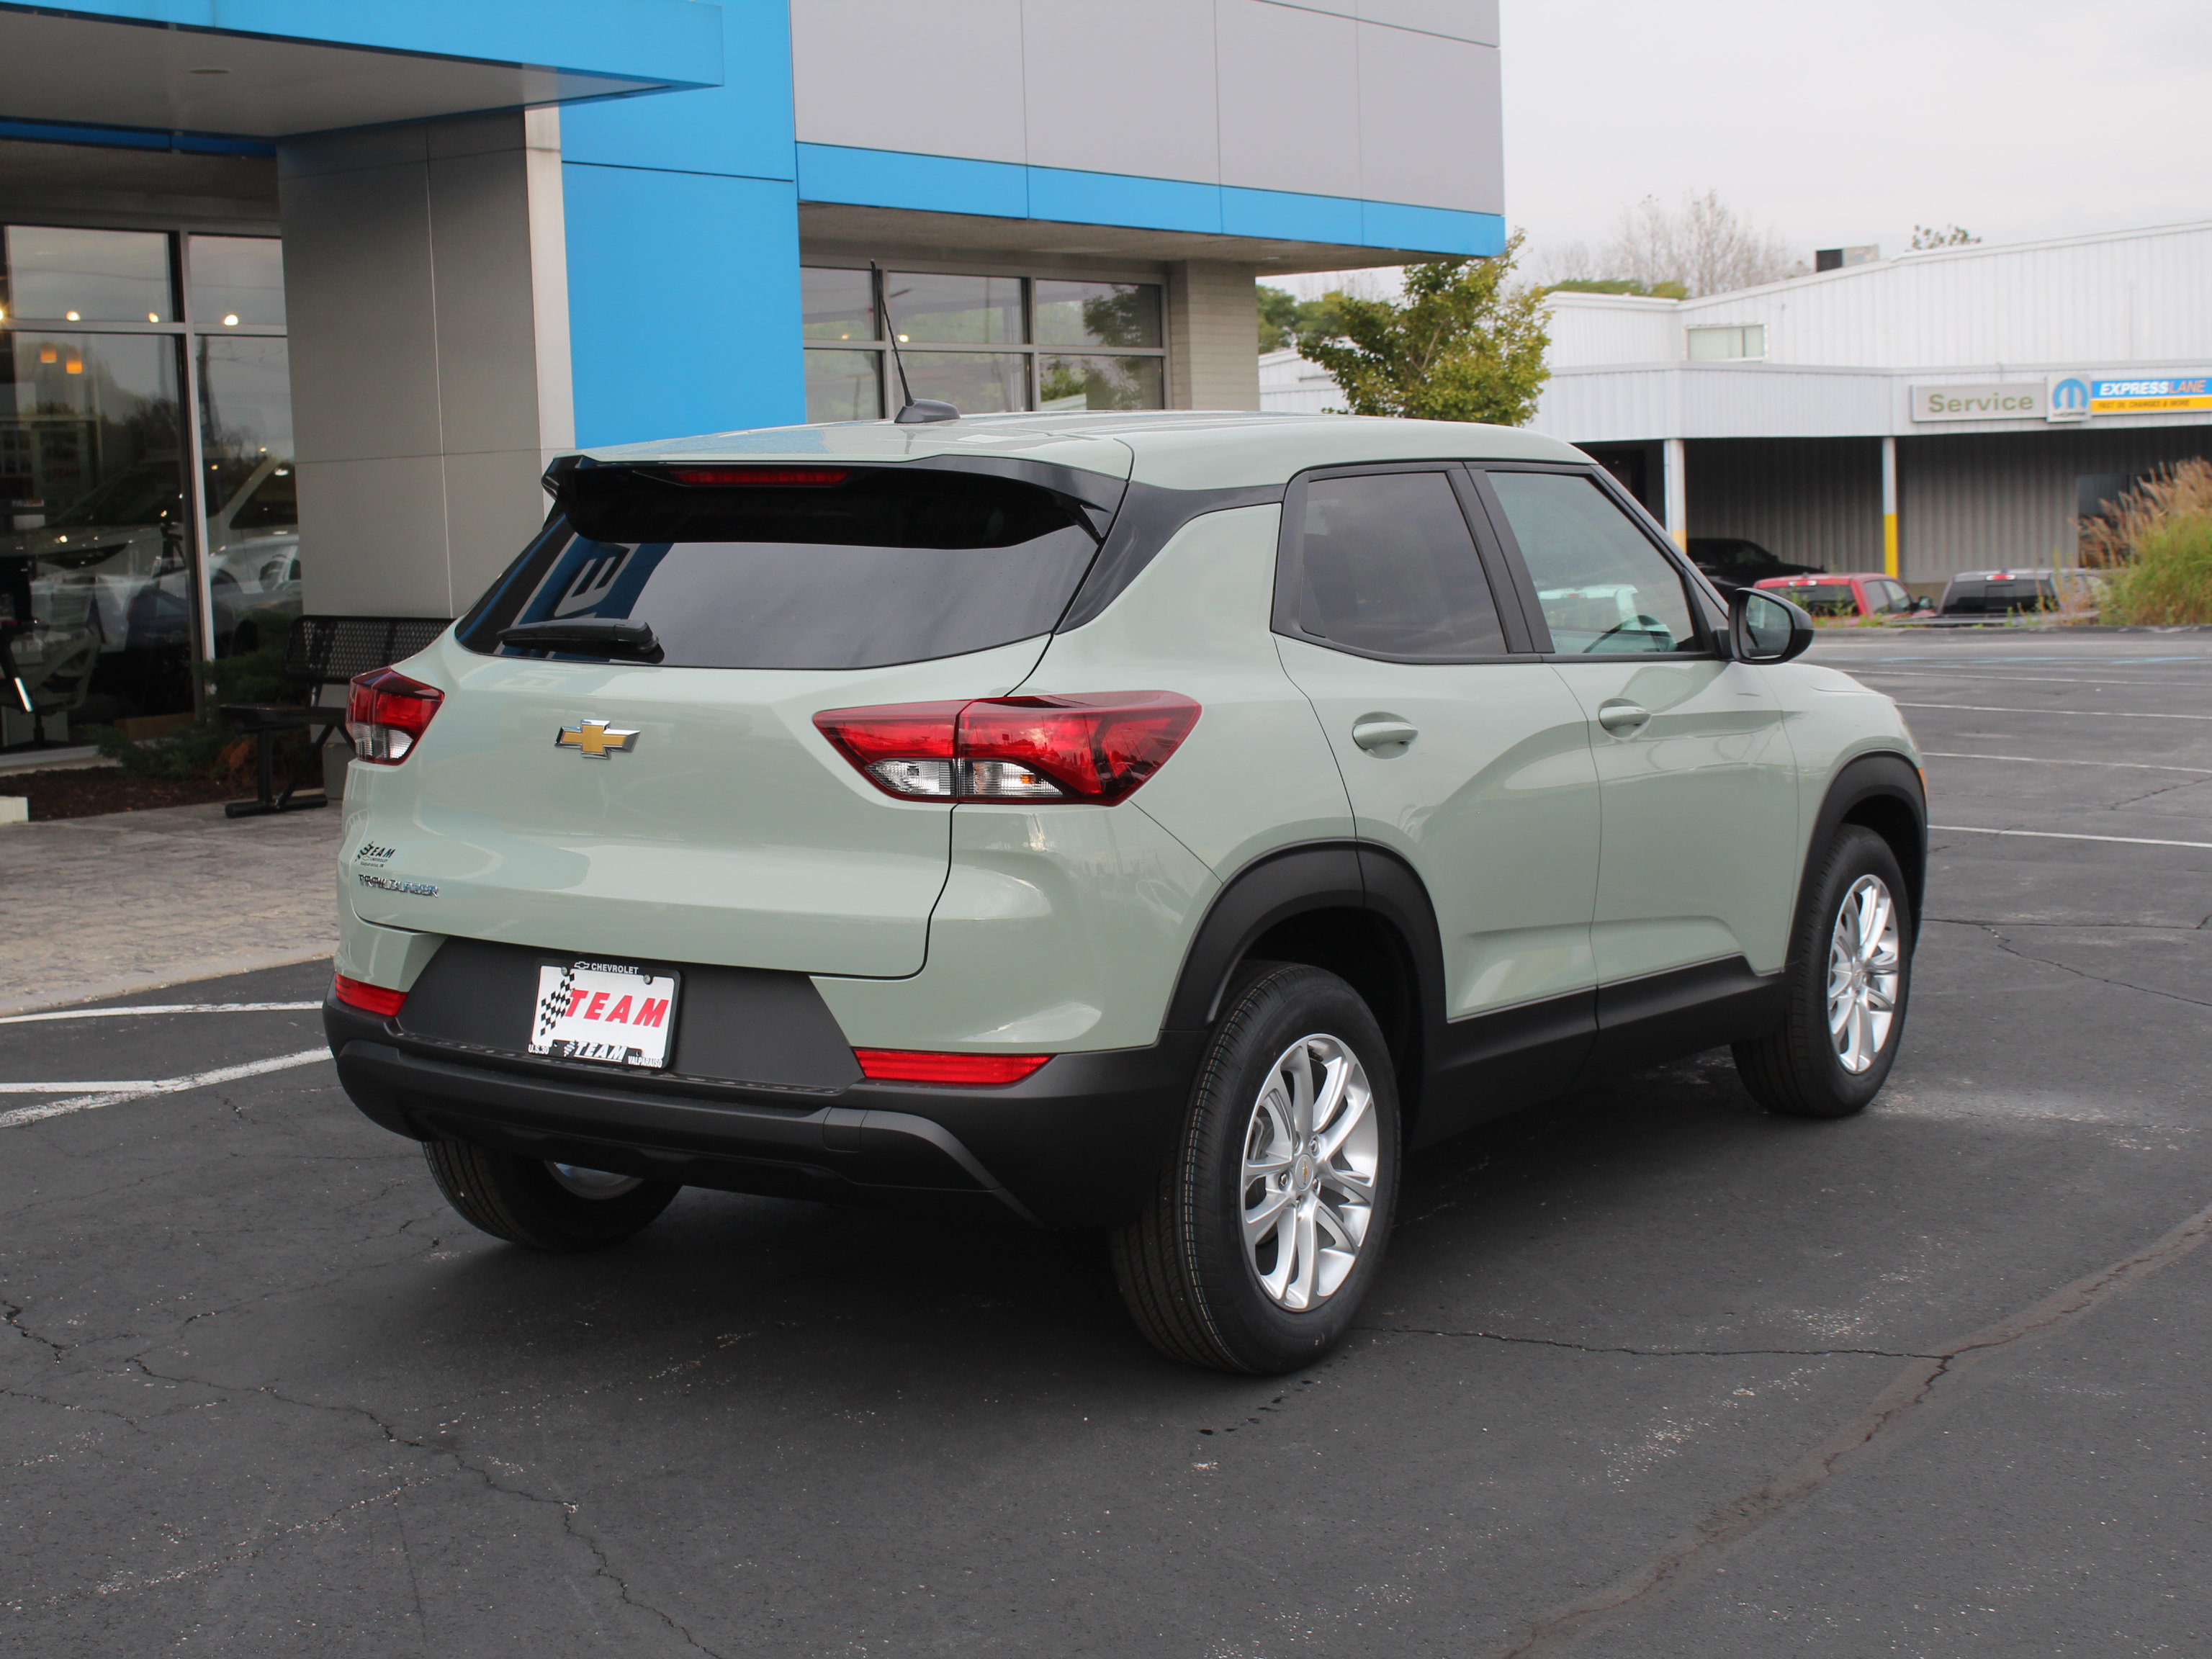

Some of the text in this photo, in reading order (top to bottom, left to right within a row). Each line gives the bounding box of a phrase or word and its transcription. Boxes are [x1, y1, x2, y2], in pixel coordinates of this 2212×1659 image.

[1928, 392, 2033, 413] Service
[591, 963, 639, 975] CHEVROLET
[564, 989, 669, 1028] TEAM
[574, 1041, 629, 1062] TEAM
[627, 1055, 663, 1069] VALPARAISO
